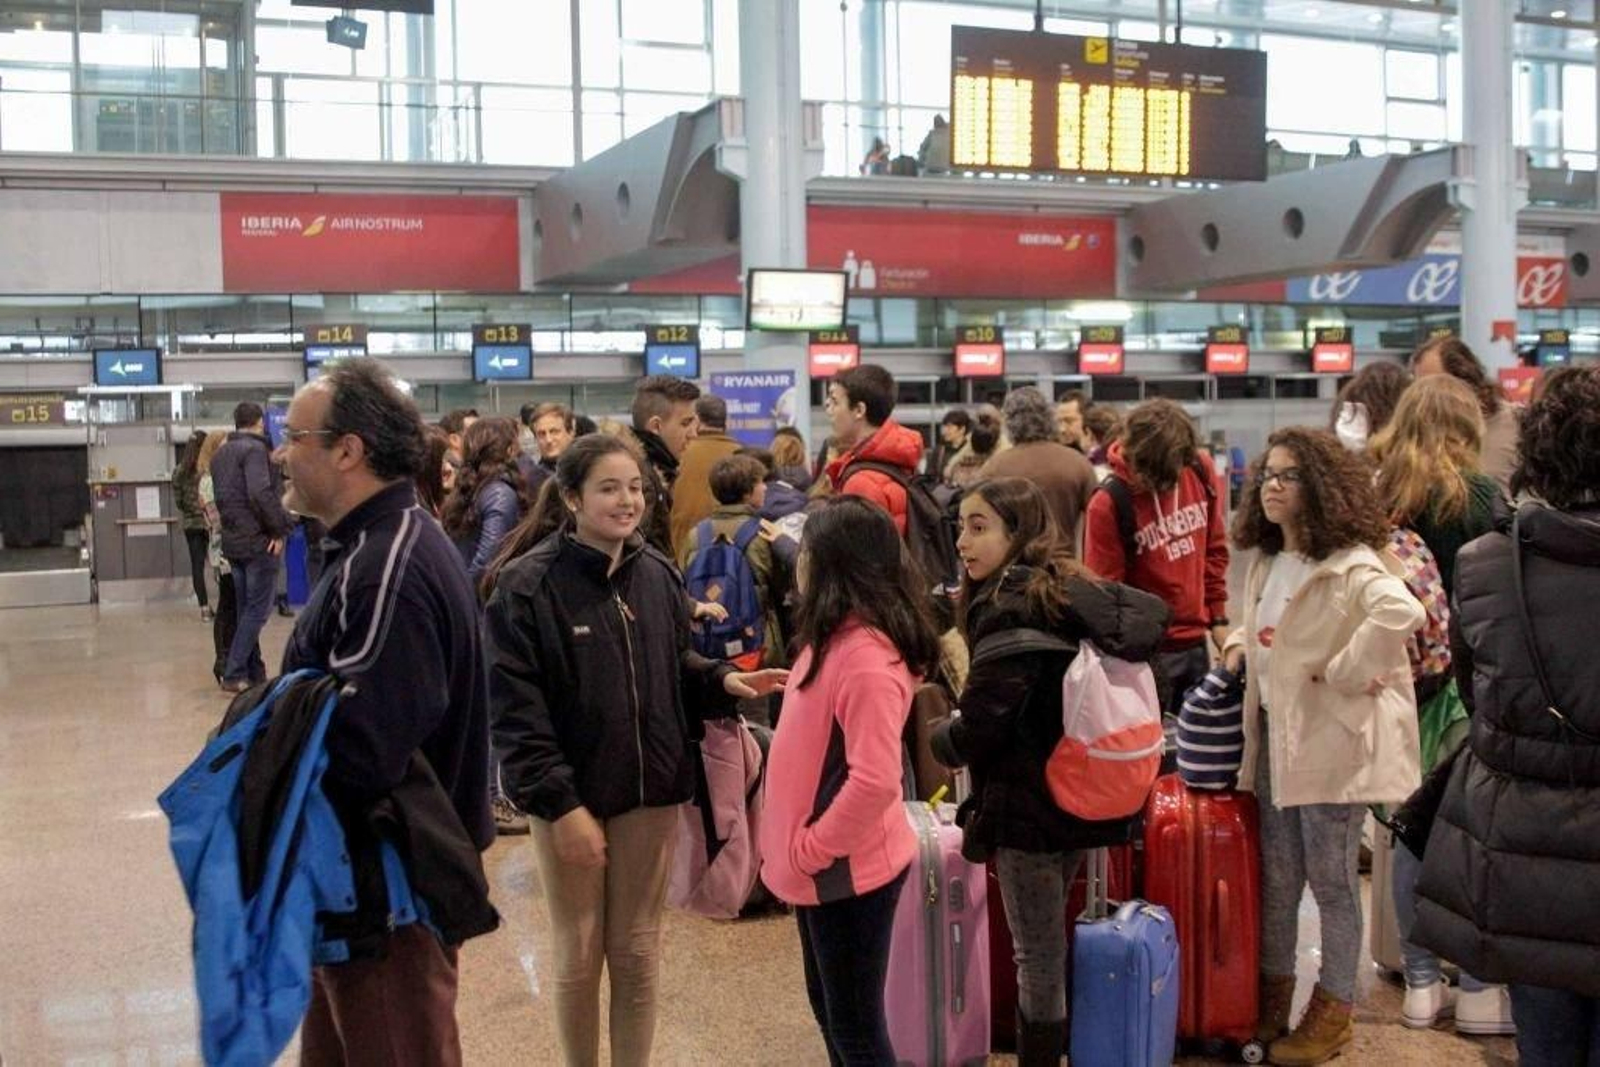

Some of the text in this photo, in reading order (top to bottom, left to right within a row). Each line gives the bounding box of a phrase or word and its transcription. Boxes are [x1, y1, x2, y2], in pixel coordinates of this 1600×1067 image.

[241, 216, 303, 229] IBERIA
[1018, 233, 1064, 246] IBERIA
[332, 326, 353, 342] 14
[499, 326, 518, 342] 13
[670, 326, 688, 342] 12
[978, 327, 994, 342] 10
[723, 375, 791, 388] RYANAIR
[26, 405, 50, 422] 15
[1165, 535, 1196, 561] 1991
